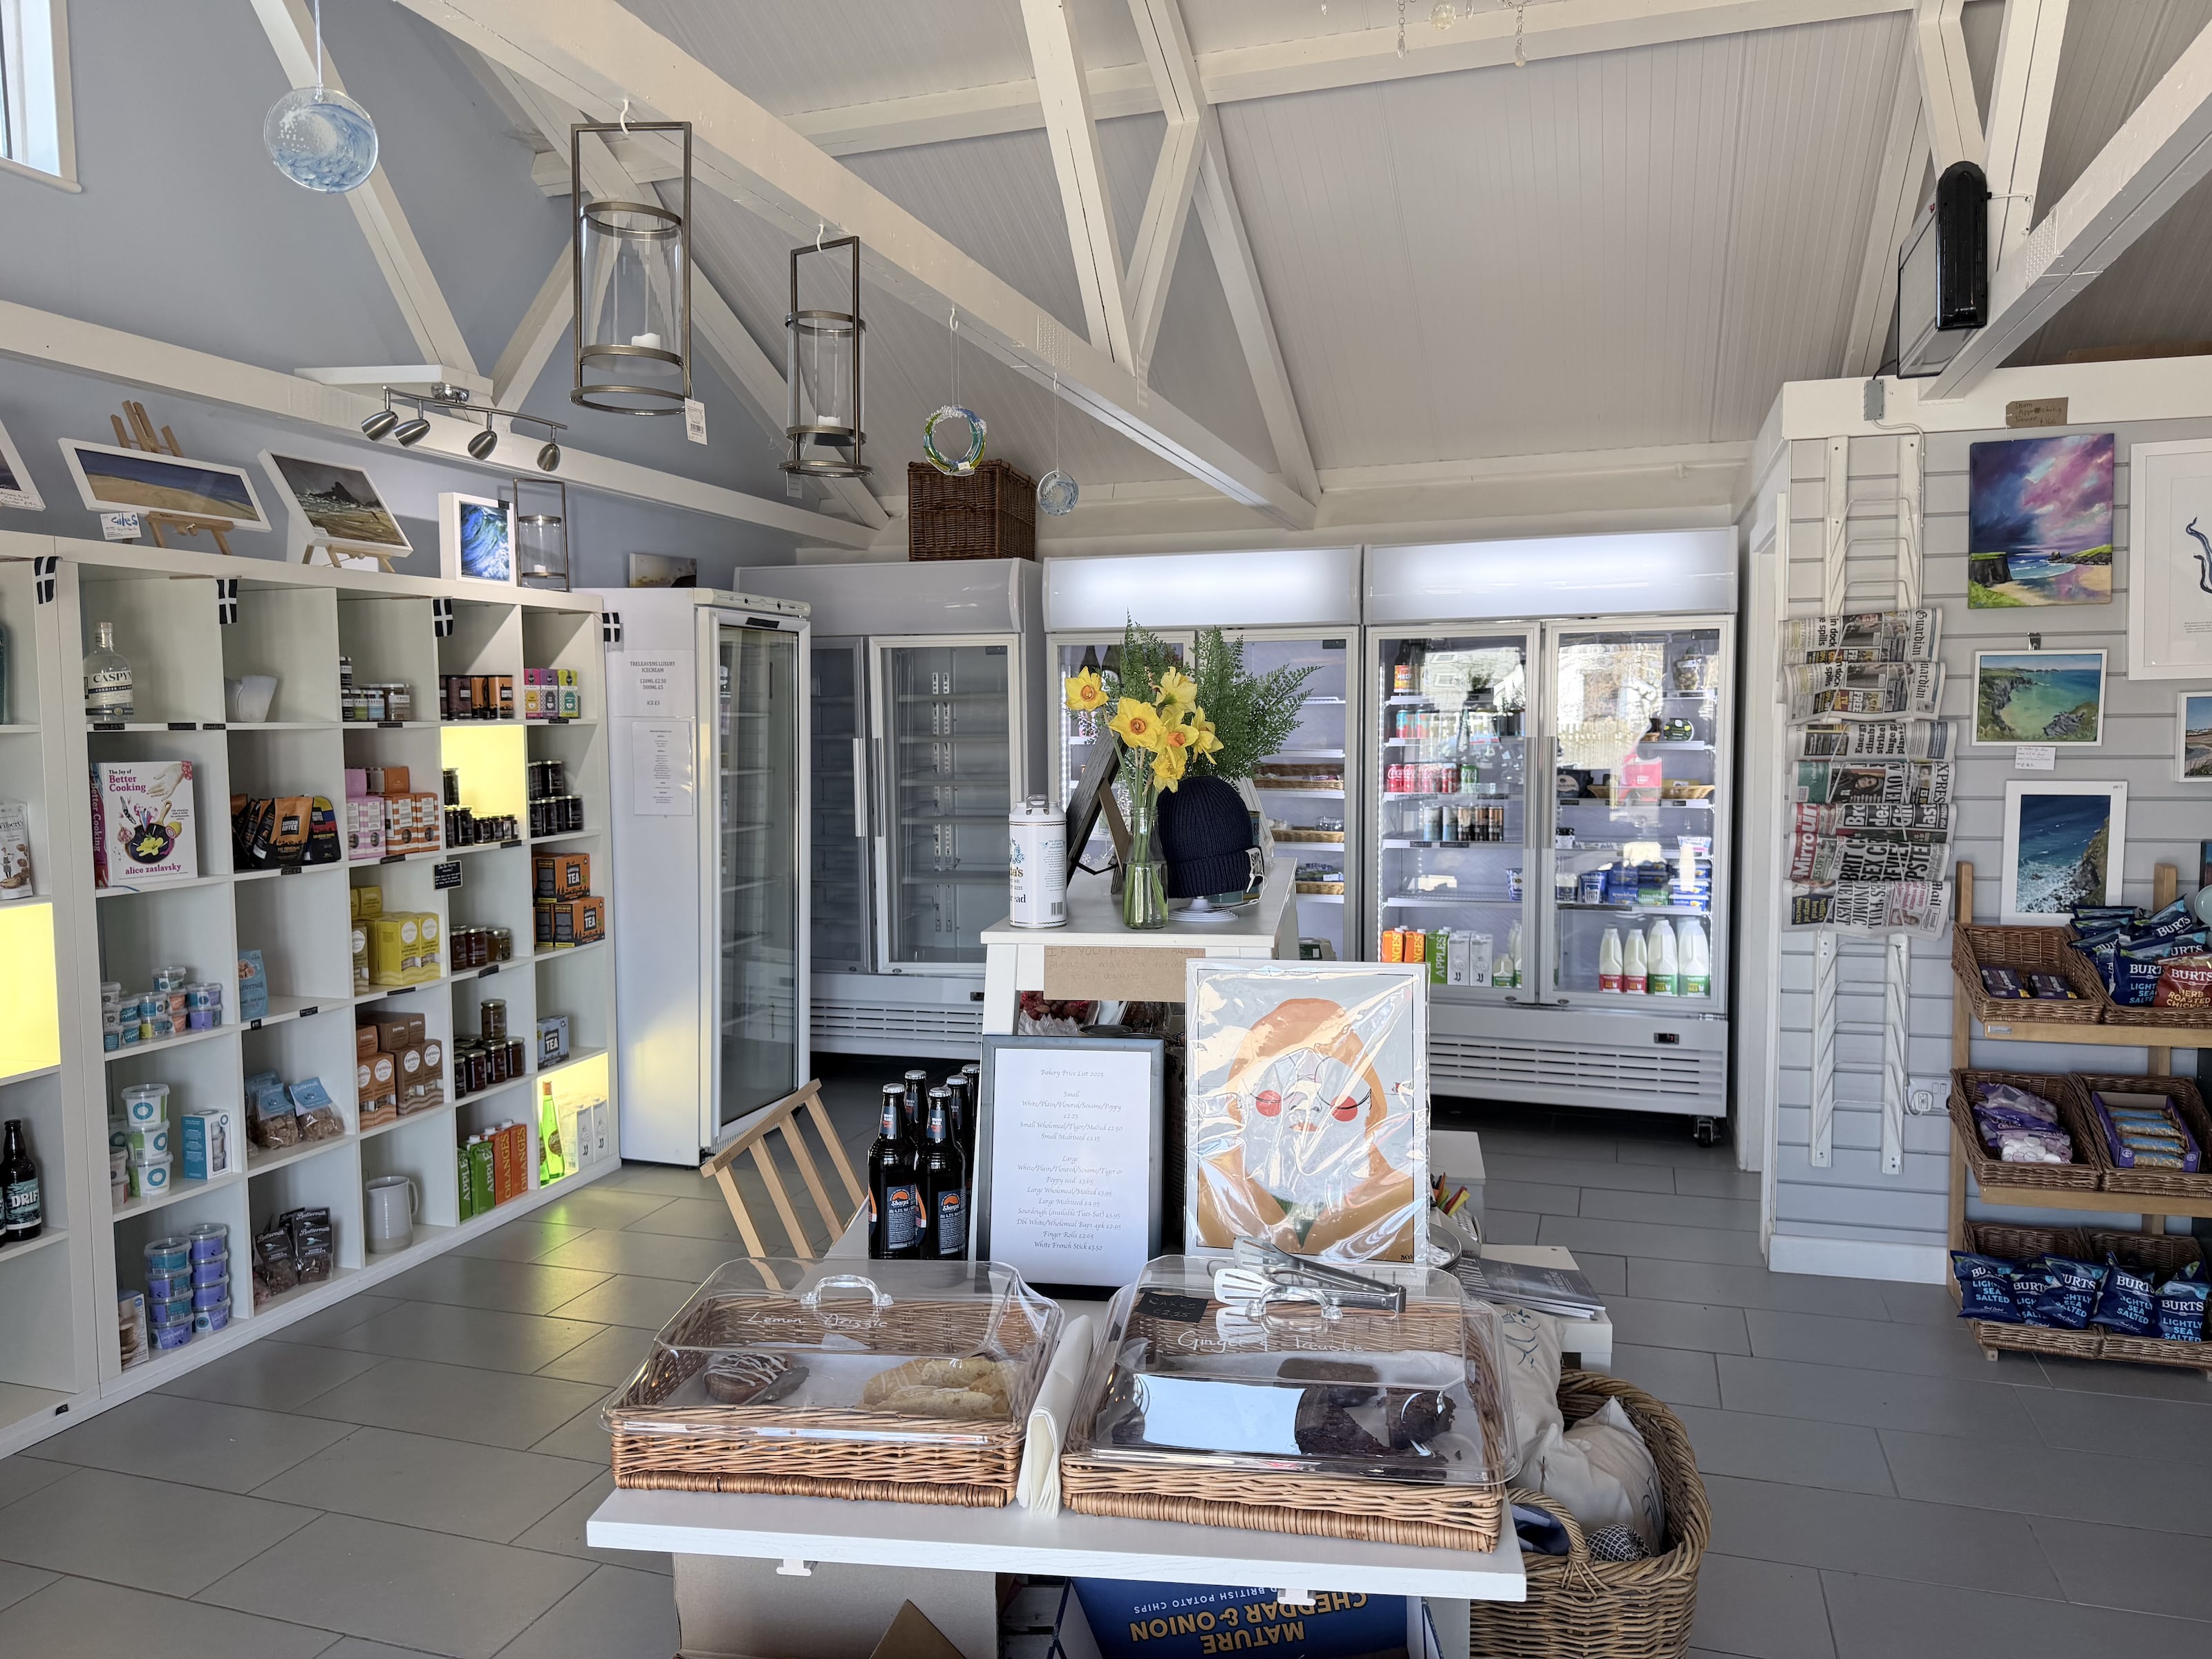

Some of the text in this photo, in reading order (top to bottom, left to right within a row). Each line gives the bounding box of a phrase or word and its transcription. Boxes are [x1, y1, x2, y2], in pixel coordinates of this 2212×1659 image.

[1818, 624, 1827, 646] spills
[1829, 628, 1839, 648] dock
[1911, 610, 1929, 656] Guardian
[1915, 663, 1930, 699] uardian
[1852, 691, 1864, 713] FREE
[109, 775, 137, 783] Better
[1933, 763, 1950, 803] XPRES
[109, 783, 146, 793] Cooking
[1801, 803, 1817, 832] un
[93, 814, 102, 852] Cooking
[1792, 832, 1815, 877] Mirro
[1882, 841, 1909, 881] REVIE
[125, 863, 181, 874] alice zaslavsky
[568, 872, 580, 885] TEA
[1836, 897, 1851, 926] WEST
[585, 916, 596, 928] TEA
[2155, 915, 2192, 937] BURTS
[1078, 947, 1100, 956] YOU
[1392, 935, 1402, 962] NGES
[1414, 935, 1423, 962] NGES
[1436, 936, 1446, 978] APPLES
[2170, 944, 2204, 956] URTS
[2129, 964, 2165, 975] BURT
[2171, 968, 2212, 982] BURTS
[2168, 991, 2211, 1004] ROASTED
[546, 1040, 559, 1051] TEA
[1040, 1069, 1060, 1078] Bakery
[500, 1133, 512, 1198] ORANGES
[517, 1127, 527, 1190] ORANGES
[1061, 1155, 1078, 1164] Large
[458, 1153, 471, 1201] APPLES
[482, 1145, 494, 1192] APPLE
[11, 1190, 39, 1208] DRIF
[1027, 1186, 1043, 1196] Large
[1038, 1198, 1055, 1207] Large
[1018, 1207, 1047, 1217] Sourdough
[1042, 1230, 1062, 1240] Finger
[2061, 1273, 2096, 1290] URTS
[2116, 1275, 2155, 1294] BURTS
[1975, 1293, 2010, 1304] SALTED
[1983, 1287, 2002, 1295] SEA
[2127, 1304, 2145, 1315] SEA
[2161, 1300, 2204, 1312] BURTS
[747, 1312, 805, 1324] Lemon
[2116, 1307, 2149, 1325] SALTED
[2162, 1317, 2203, 1329] LIGHTLY
[2164, 1333, 2202, 1343] SALTED
[2173, 1327, 2193, 1335] SEA
[1134, 1587, 1266, 1615] BRITISH POTATO CHIPS
[1219, 1606, 1239, 1627] &
[1129, 1611, 1215, 1642] ONION
[1199, 1620, 1305, 1655] MATURE
